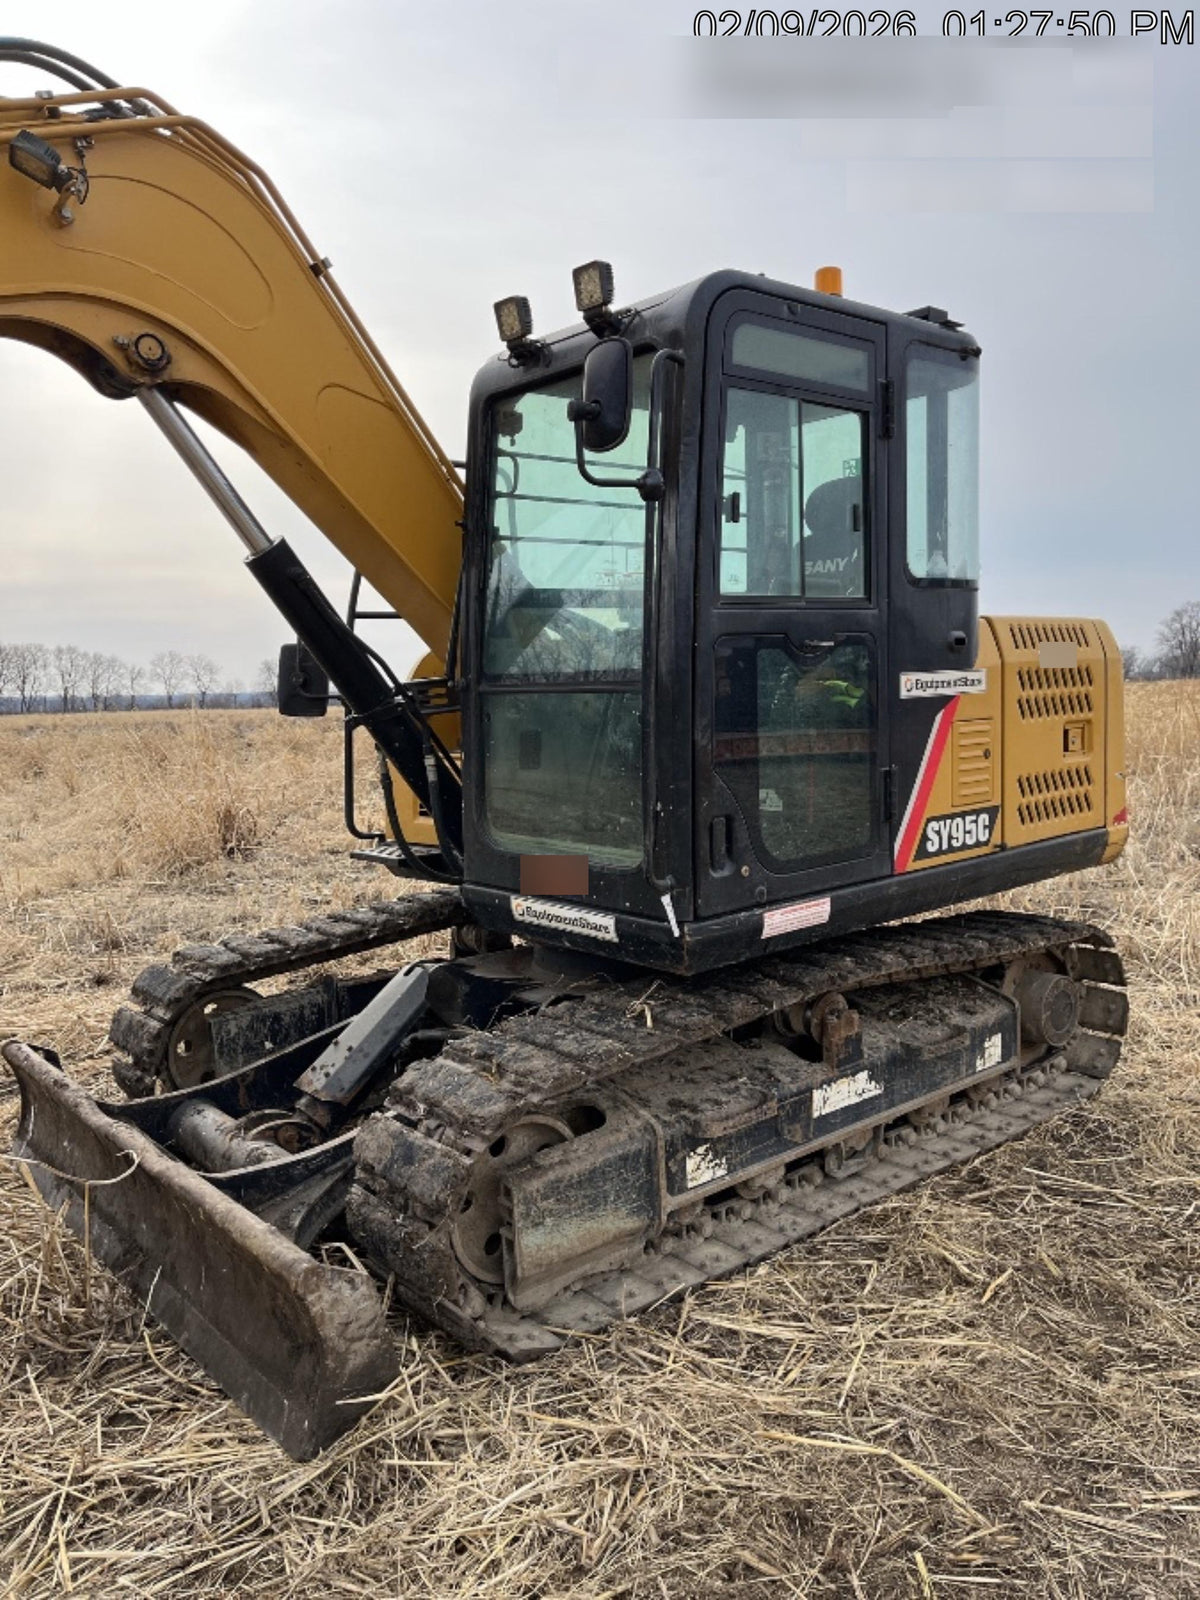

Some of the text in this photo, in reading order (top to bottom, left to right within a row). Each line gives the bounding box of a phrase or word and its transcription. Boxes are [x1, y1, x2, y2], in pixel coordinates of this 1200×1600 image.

[804, 556, 849, 575] SANY
[926, 813, 990, 853] SY95C
[526, 905, 611, 935] EquipmentShare
